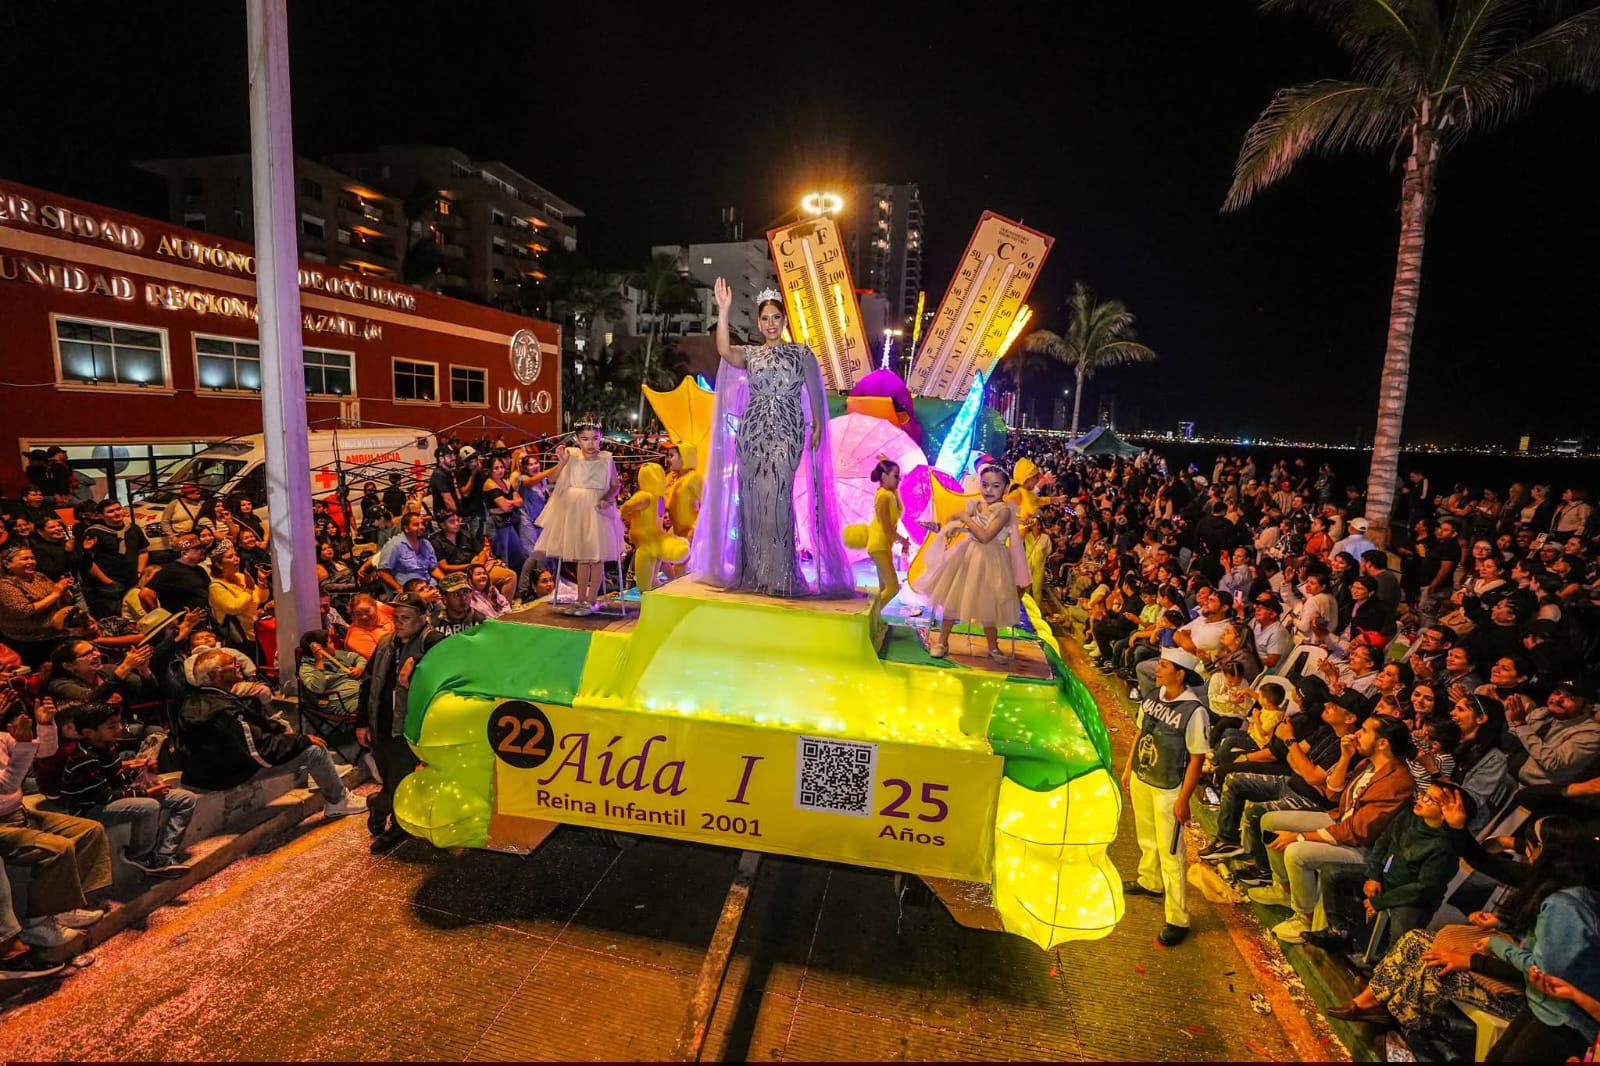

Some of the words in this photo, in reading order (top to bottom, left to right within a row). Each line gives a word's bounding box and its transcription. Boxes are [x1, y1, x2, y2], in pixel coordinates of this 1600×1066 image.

[823, 248, 839, 261] 120
[970, 249, 982, 259] 50
[783, 260, 795, 272] 50
[0, 255, 136, 300] UNIDAD
[829, 270, 845, 283] 100
[1017, 269, 1032, 281] 100
[298, 269, 324, 291] DE
[325, 276, 417, 311] OCCIDENTE
[788, 279, 800, 290] 40
[943, 306, 954, 317] 20
[935, 327, 946, 337] 10
[850, 358, 862, 370] 20
[1142, 698, 1182, 729] MARINA
[497, 715, 546, 757] 22
[537, 732, 687, 797] Aída
[726, 755, 765, 805] I
[879, 778, 949, 823] 25
[536, 790, 597, 814] Reina
[604, 799, 686, 827] Infantil
[701, 813, 763, 837] 2001
[878, 824, 946, 847] Años
